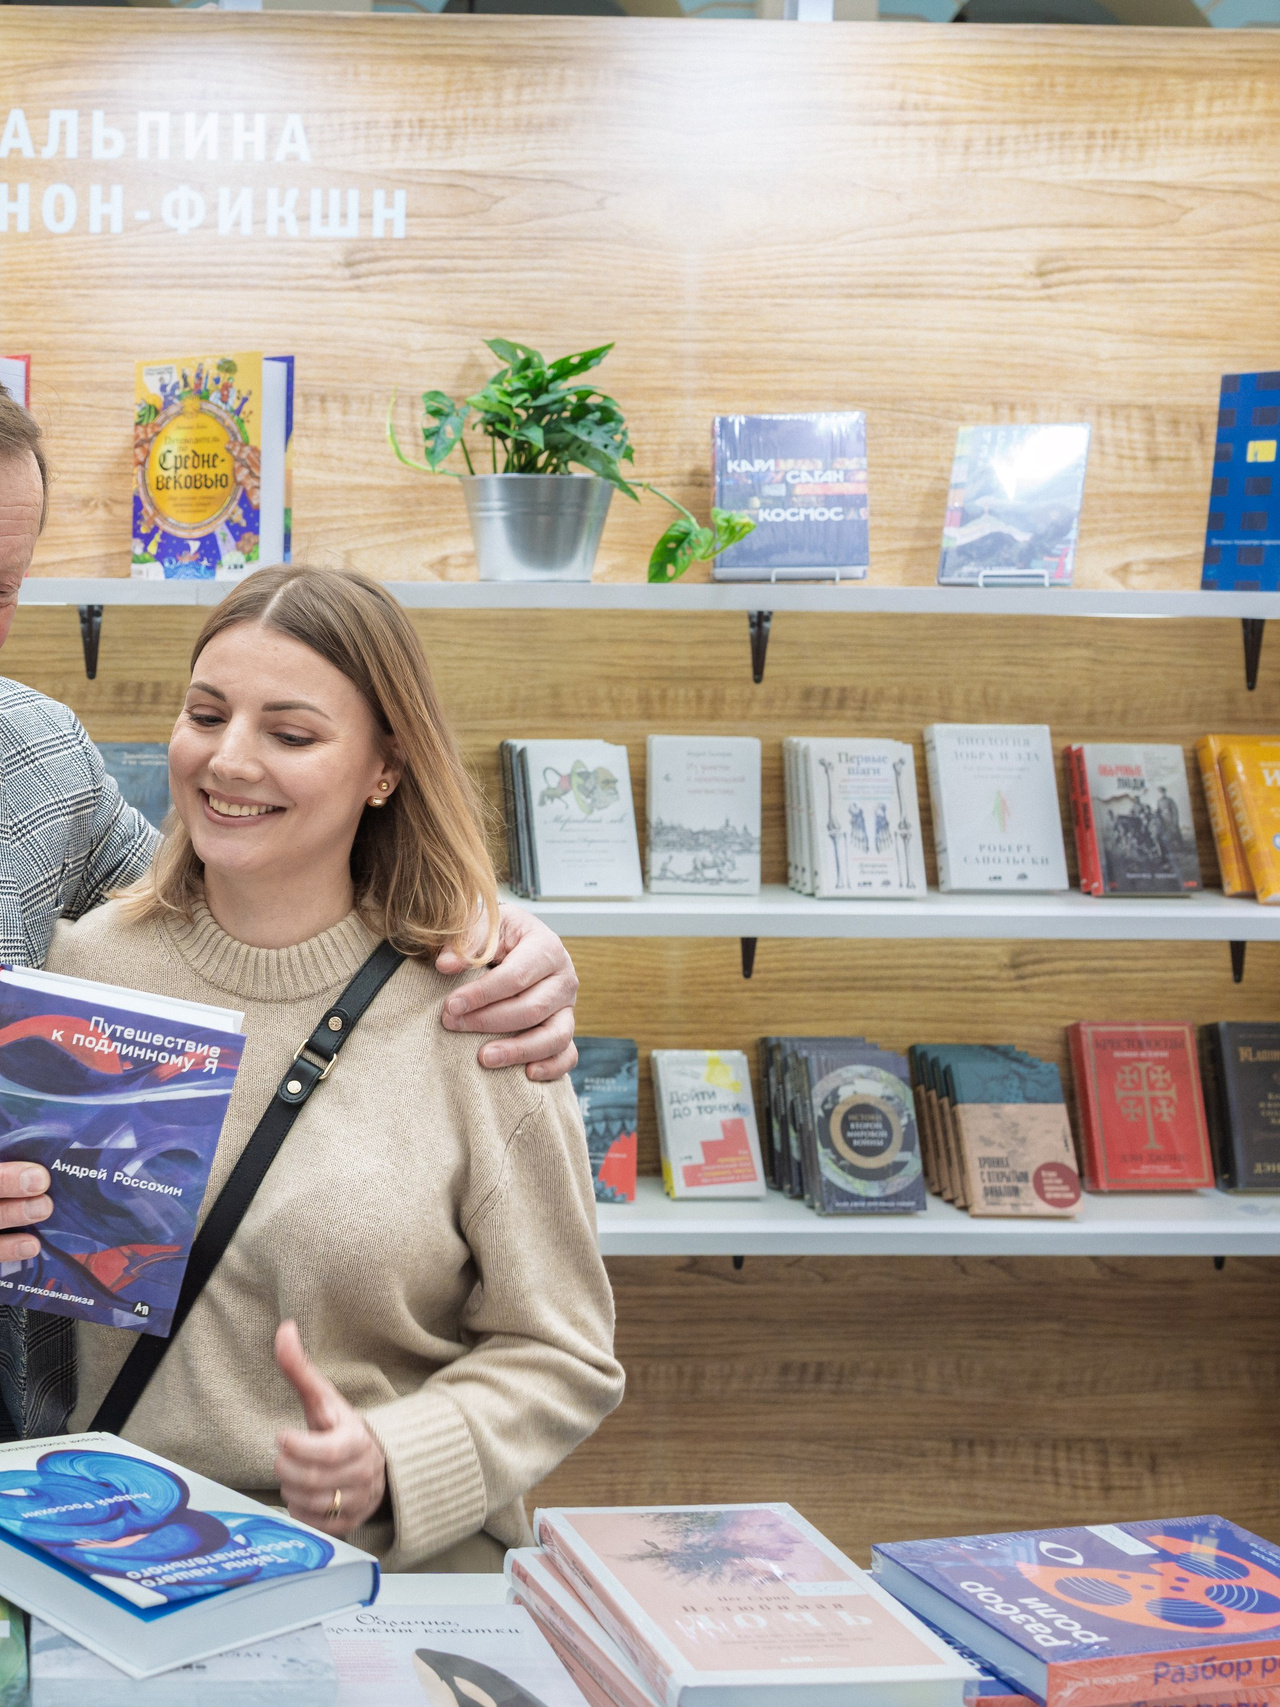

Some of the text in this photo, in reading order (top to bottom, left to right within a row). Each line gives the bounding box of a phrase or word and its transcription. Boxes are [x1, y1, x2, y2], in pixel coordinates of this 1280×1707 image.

[159, 449, 225, 476] Средне-
[727, 459, 775, 474] КАРЛ
[155, 473, 229, 491] вековью
[786, 469, 844, 485] САГАН
[759, 507, 844, 523] КОСМОС
[89, 1015, 222, 1060] Путешествие
[51, 1029, 219, 1075] к подлинному Я
[670, 1089, 716, 1105] Дойти
[672, 1105, 691, 1119] до
[51, 1158, 183, 1198] Андрей Россохин
[17, 1282, 95, 1307] психоанализа
[21, 1492, 151, 1520] Андрей Россохин
[126, 1539, 306, 1580] бессознательного
[140, 1553, 290, 1588] Тайны нашего
[959, 1580, 1071, 1648] Разбор
[1017, 1596, 1109, 1645] роли
[1154, 1656, 1253, 1685] Разбор
